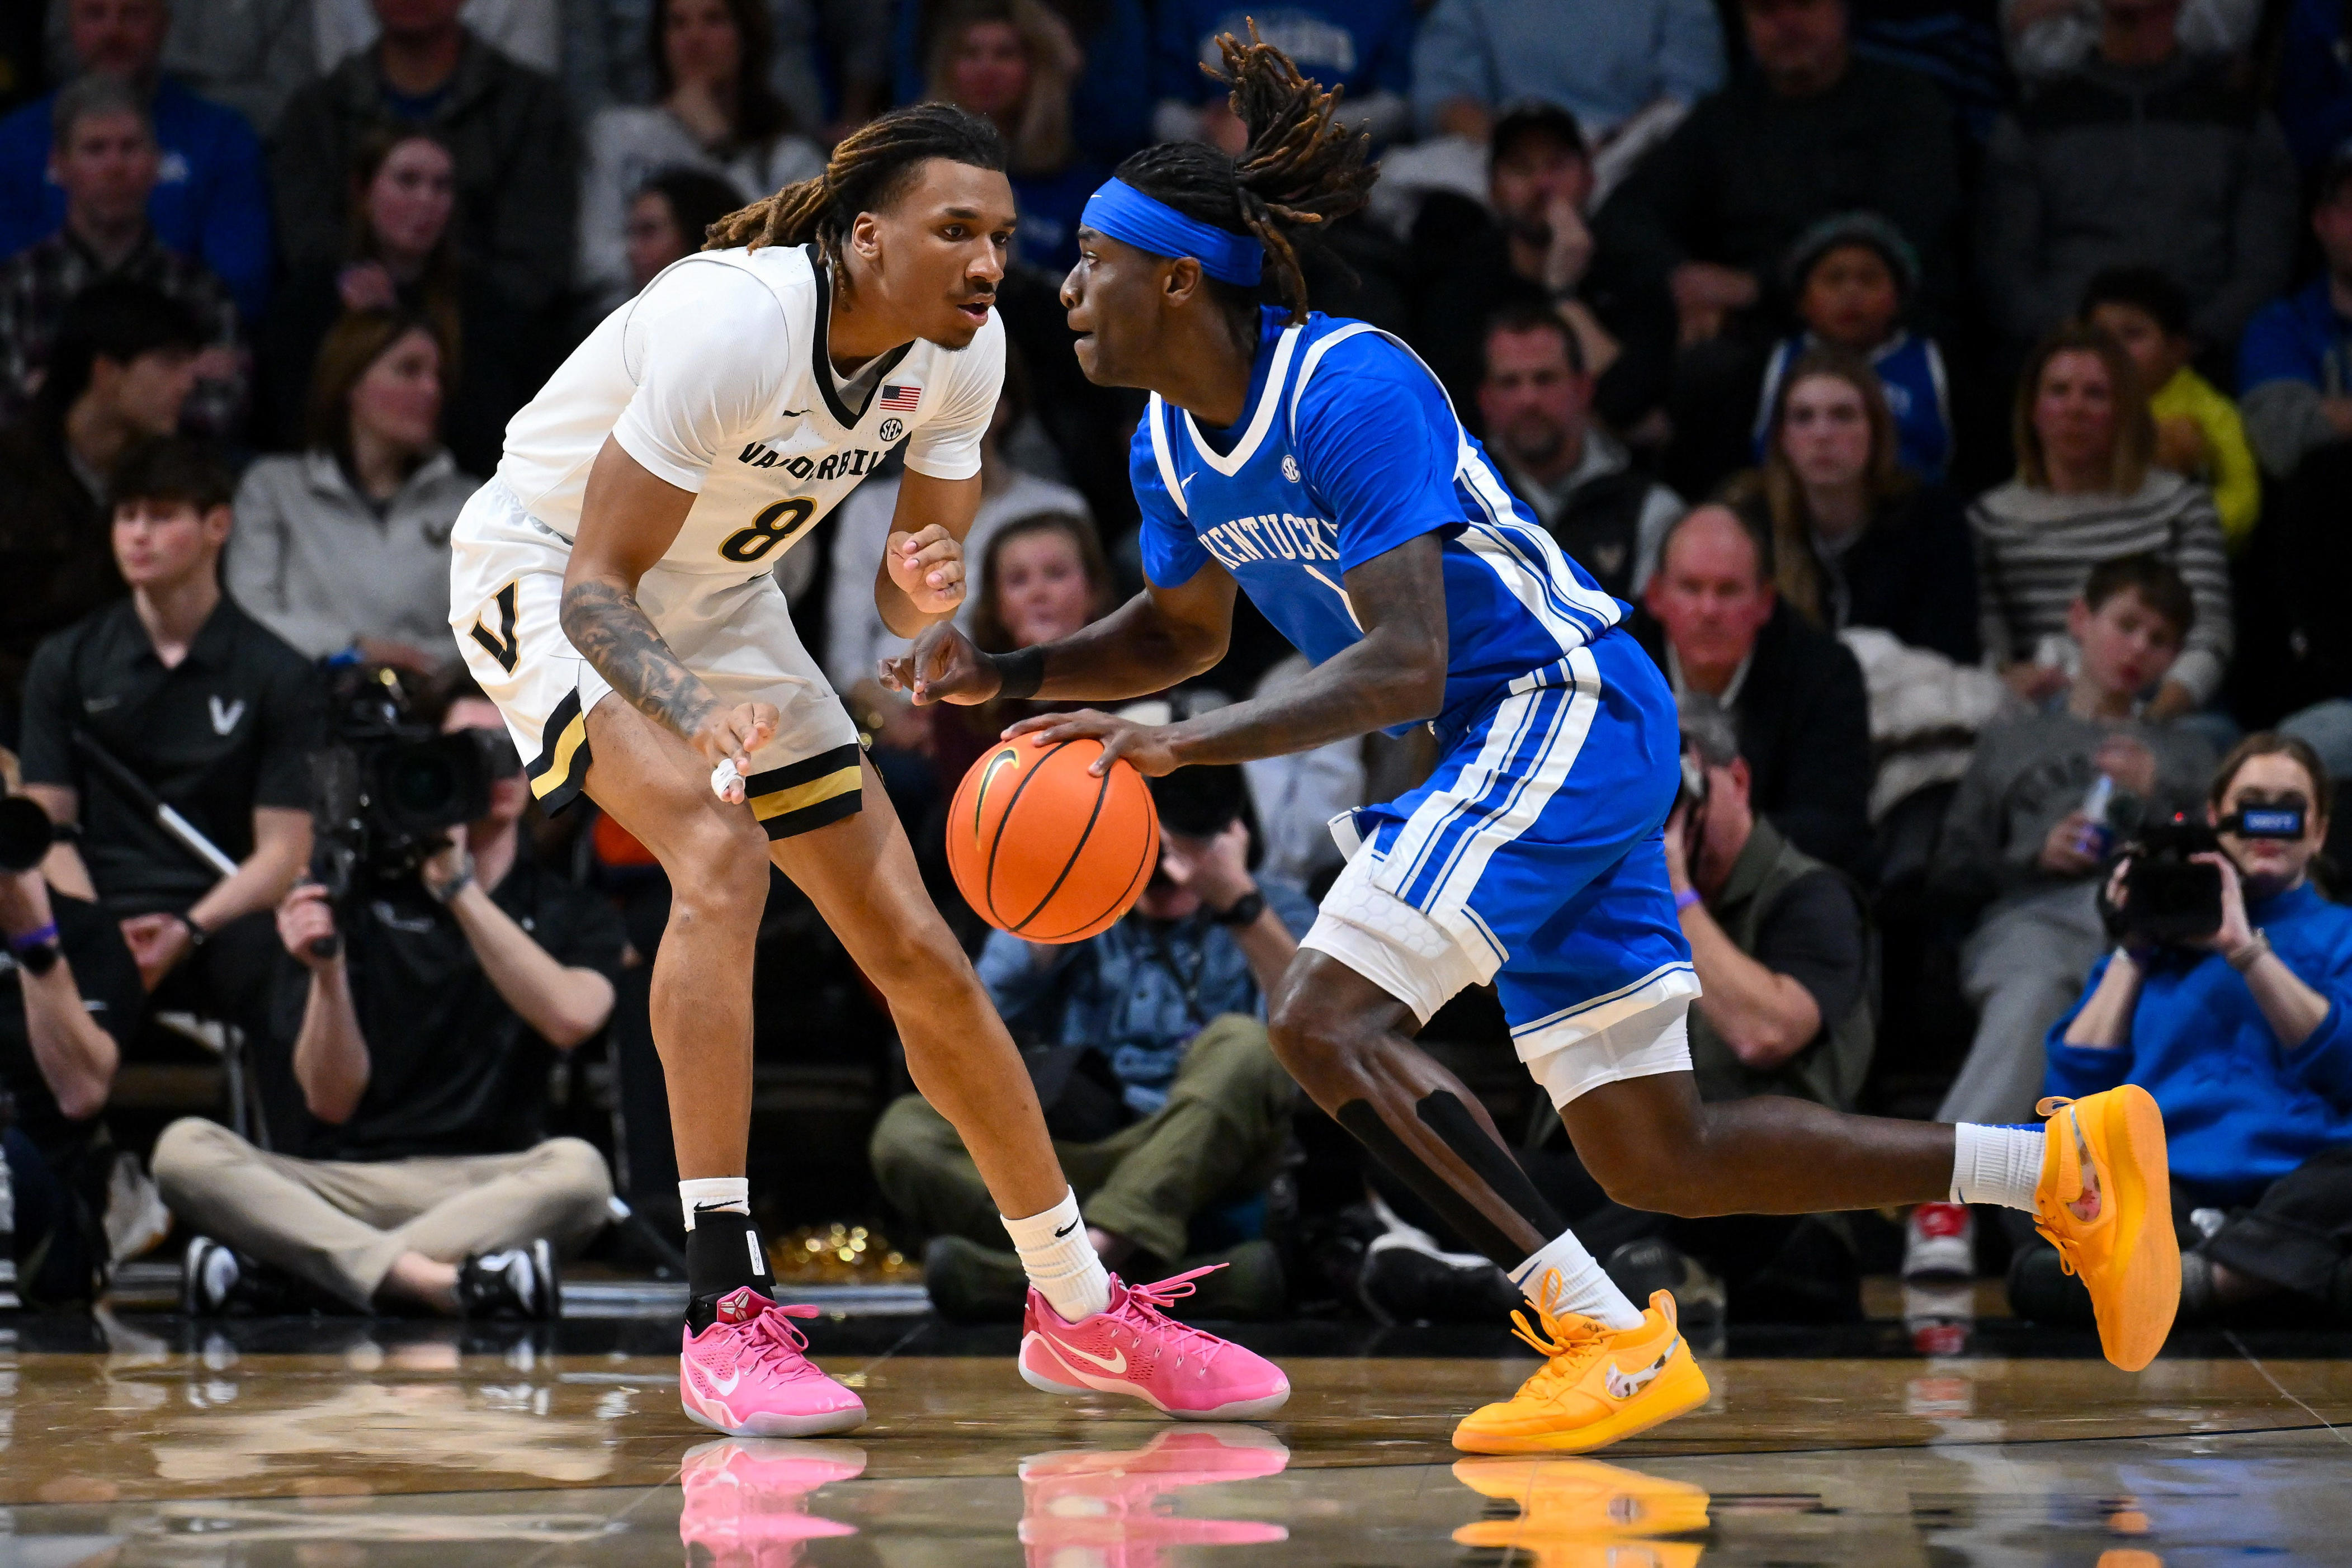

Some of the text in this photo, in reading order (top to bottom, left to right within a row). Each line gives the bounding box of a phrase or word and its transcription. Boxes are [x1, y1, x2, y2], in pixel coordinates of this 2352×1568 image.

[880, 419, 902, 441] SEC
[718, 496, 817, 563] 8
[469, 578, 520, 678] V
[208, 695, 246, 735] V
